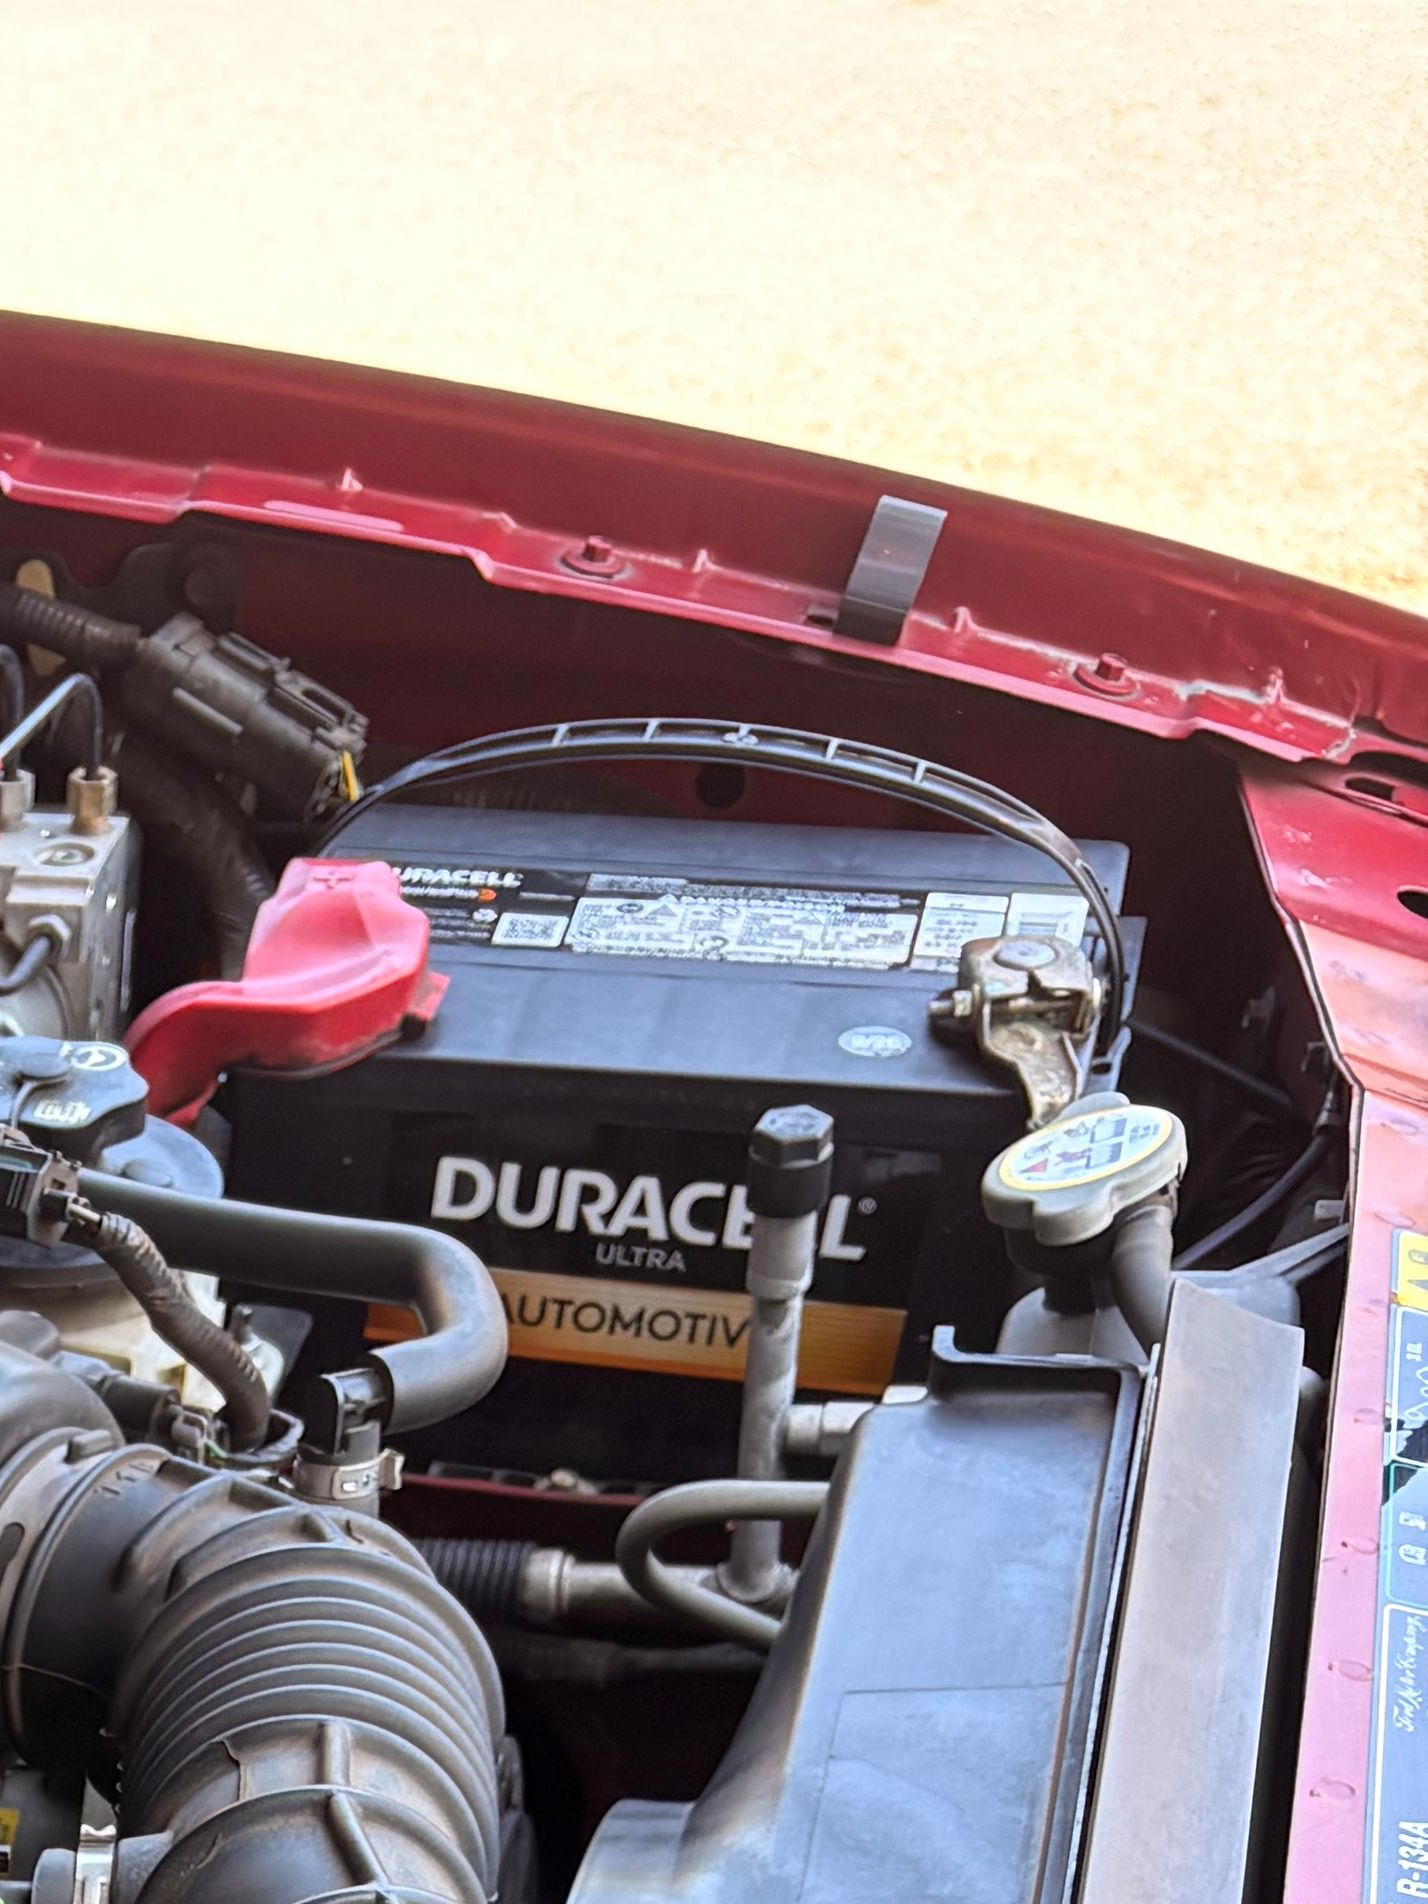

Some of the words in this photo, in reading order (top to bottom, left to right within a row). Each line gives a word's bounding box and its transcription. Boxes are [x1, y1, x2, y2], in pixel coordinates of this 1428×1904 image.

[430, 1154, 866, 1263] DURACEL
[595, 1242, 686, 1273] ULTRA
[502, 1293, 750, 1348] UTOMOTIV
[1396, 1820, 1428, 1899] R-134A
